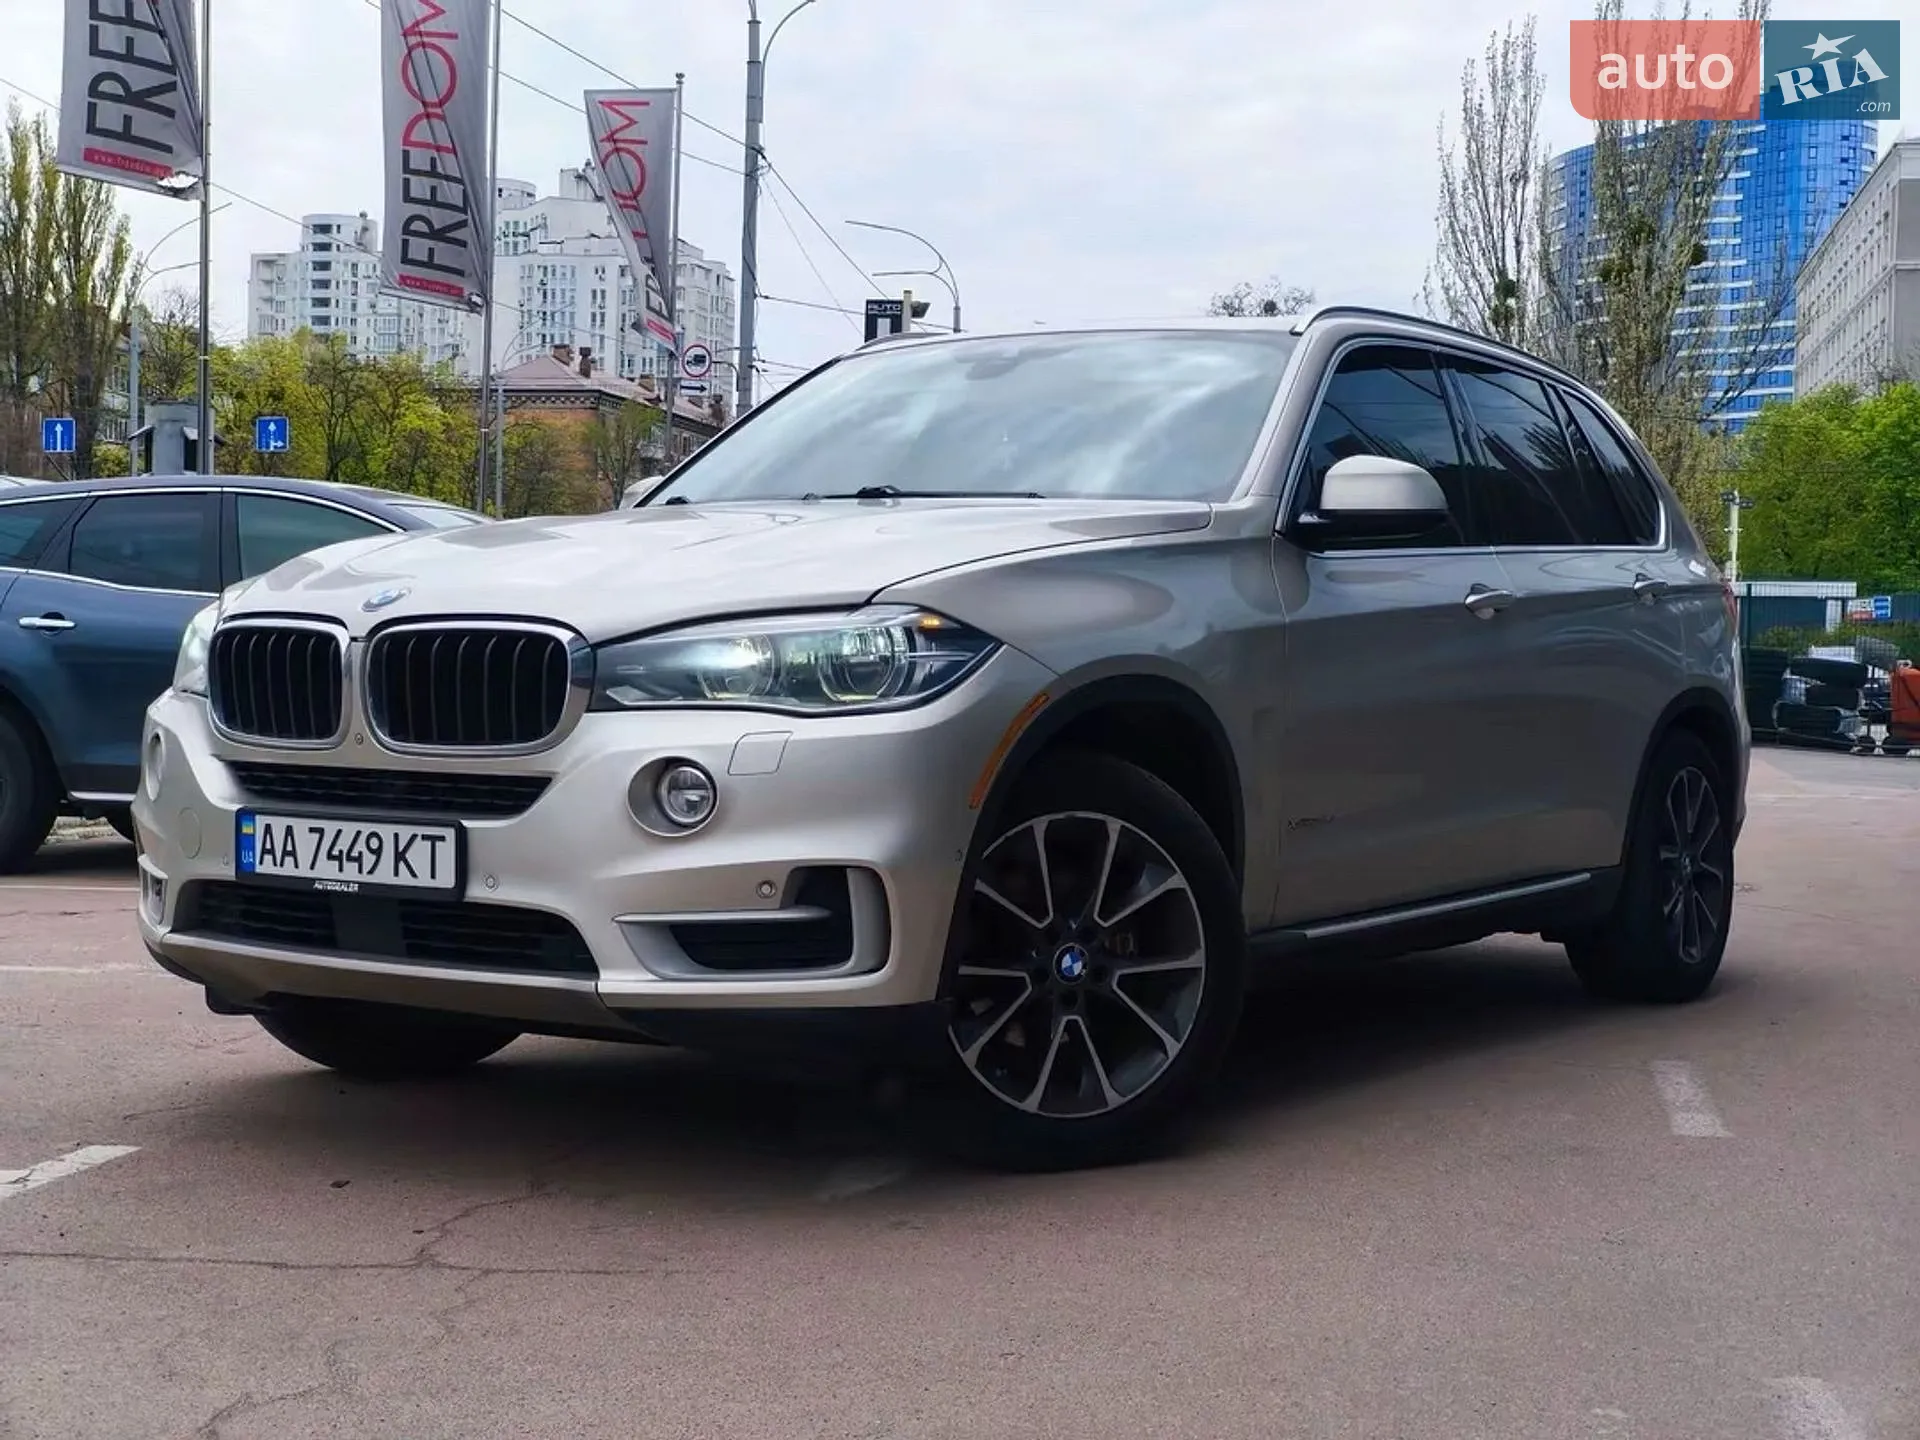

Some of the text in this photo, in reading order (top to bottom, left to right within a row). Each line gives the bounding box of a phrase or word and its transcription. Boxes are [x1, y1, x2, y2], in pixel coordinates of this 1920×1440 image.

[400, 0, 468, 278] FREEDOM
[241, 850, 254, 864] UA
[259, 823, 447, 879] AA 7449 KT
